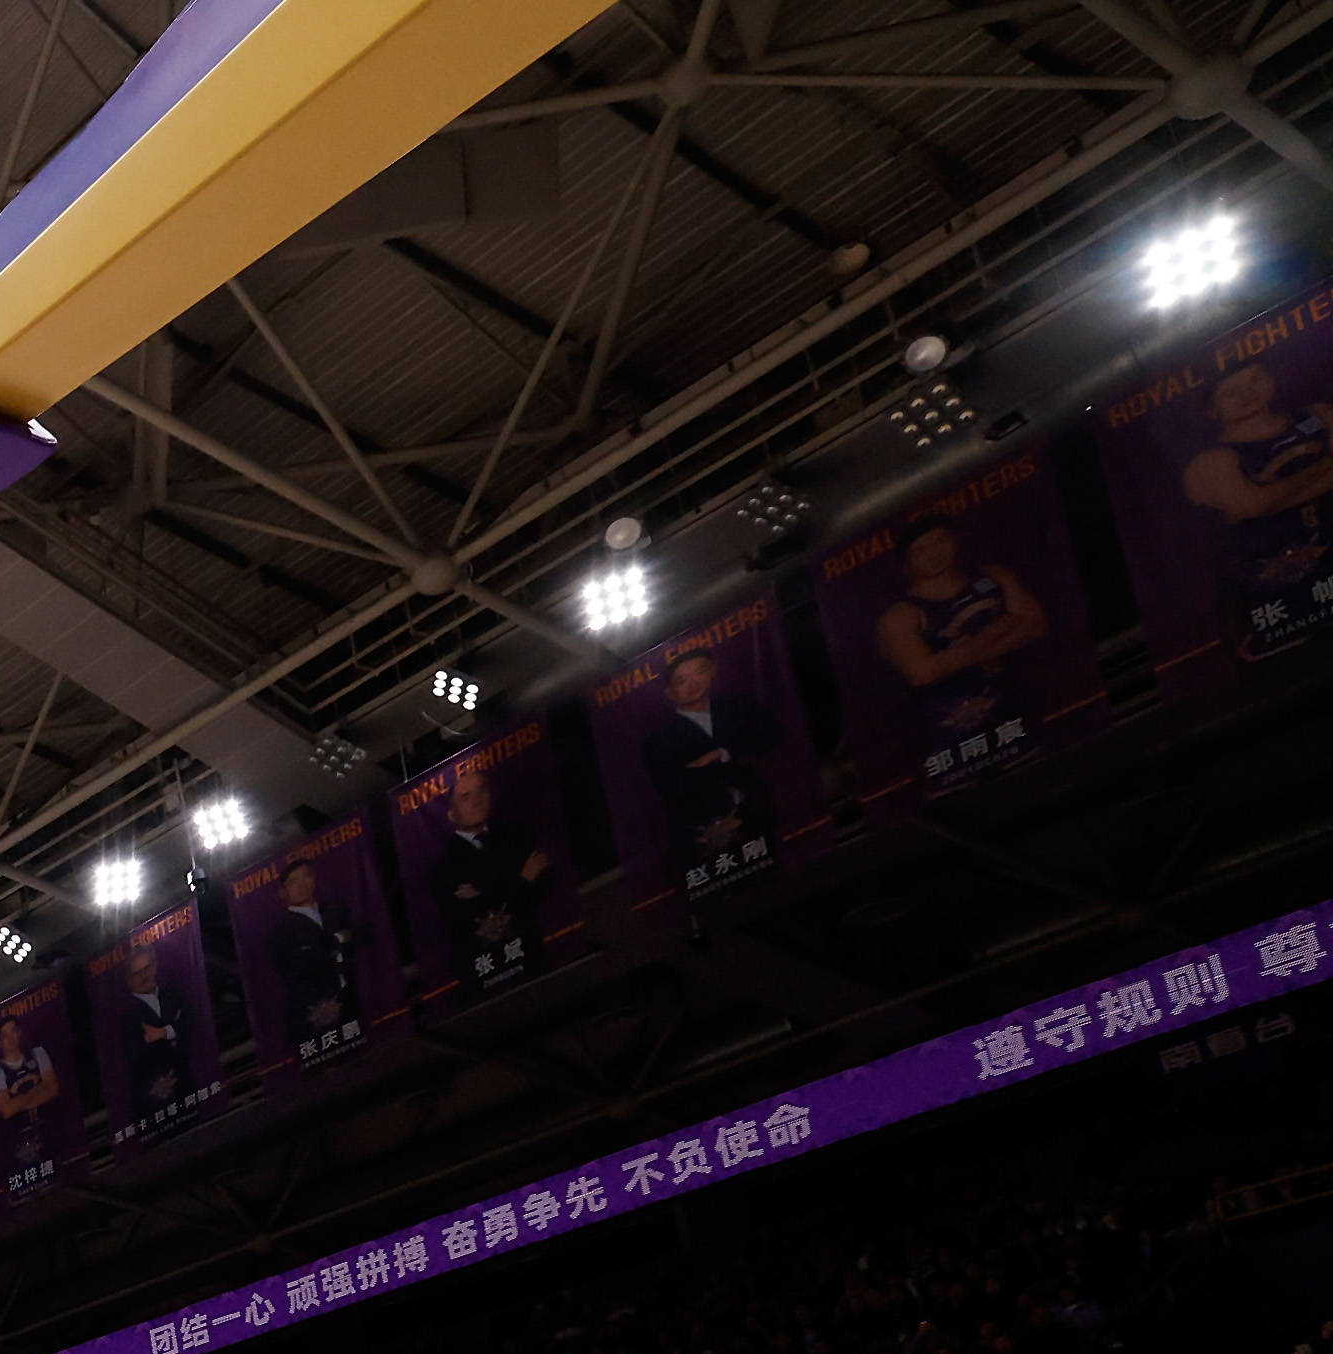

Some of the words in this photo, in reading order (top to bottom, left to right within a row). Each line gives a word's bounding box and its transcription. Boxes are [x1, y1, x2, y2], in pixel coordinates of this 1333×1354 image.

[1108, 366, 1205, 430] ROYAL
[1214, 286, 1333, 371] FIGHTE
[972, 952, 1231, 1081] 遵守规则
[1253, 918, 1333, 977] 尊
[286, 1236, 430, 1315] 顽强拼搏
[441, 1176, 610, 1262] 奋勇争先
[622, 1102, 814, 1198] 不负使命
